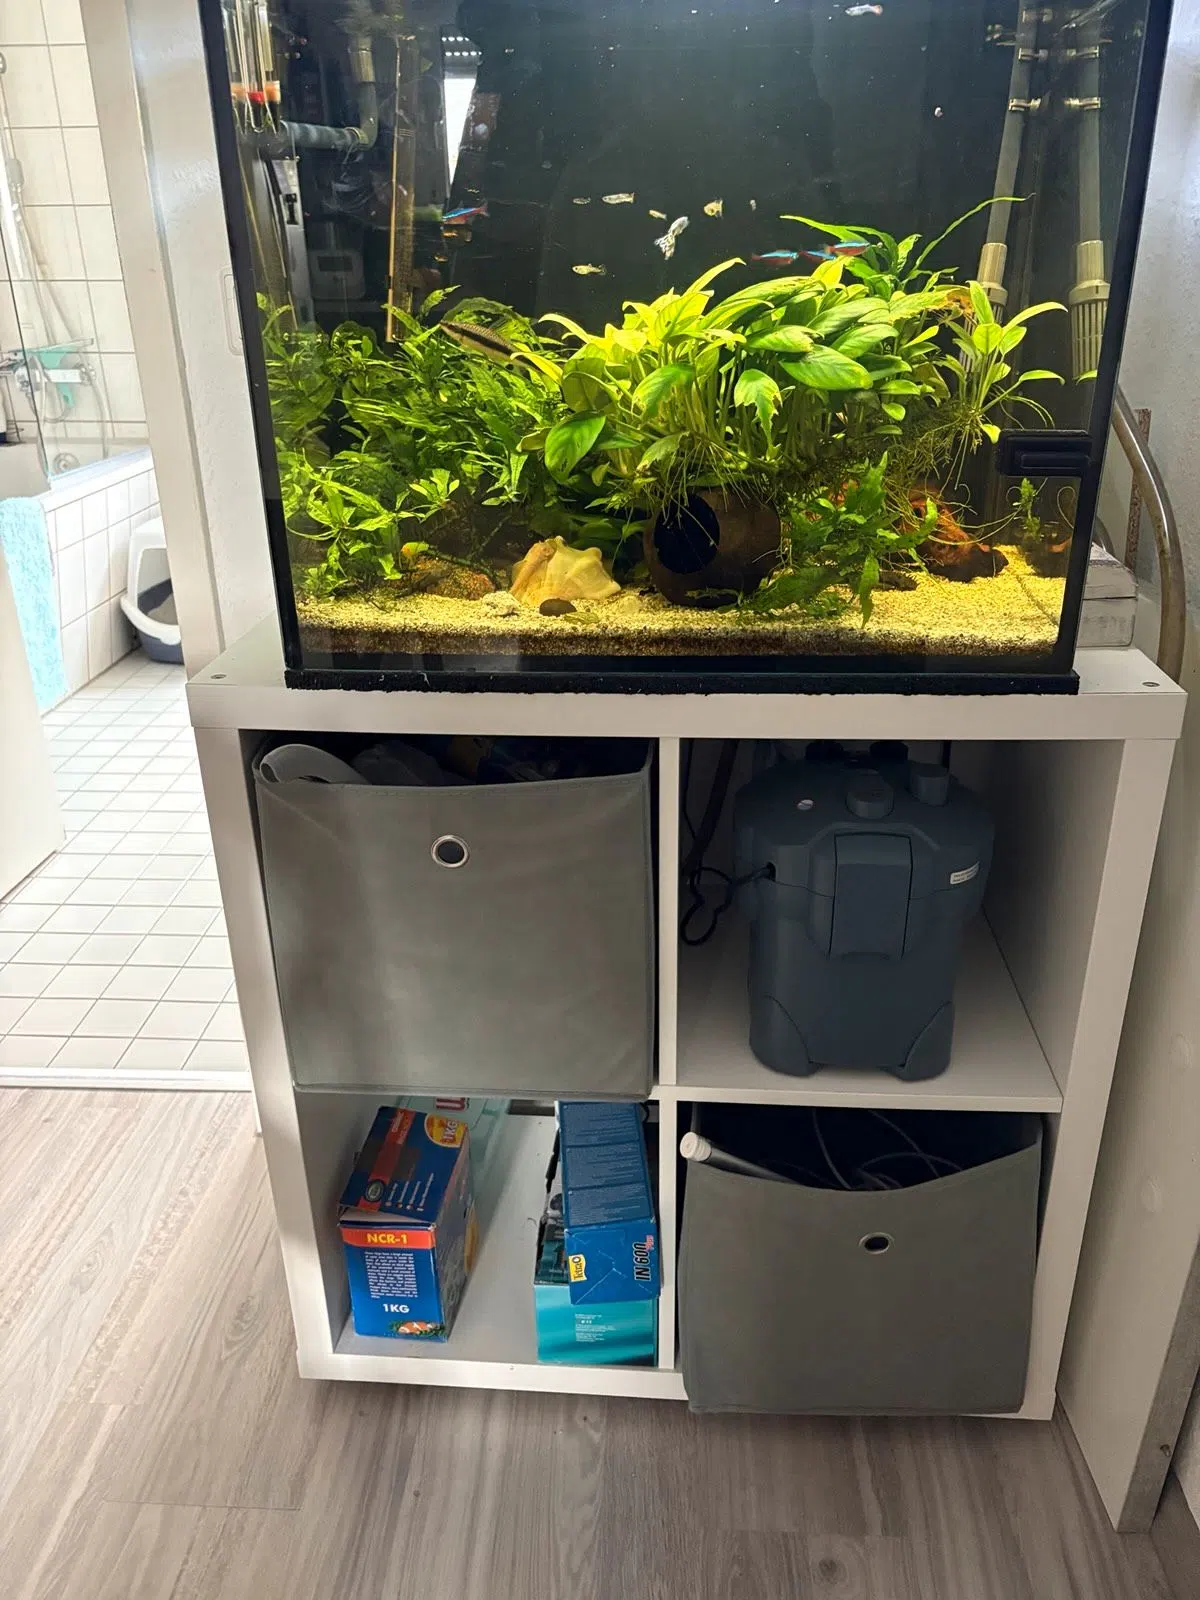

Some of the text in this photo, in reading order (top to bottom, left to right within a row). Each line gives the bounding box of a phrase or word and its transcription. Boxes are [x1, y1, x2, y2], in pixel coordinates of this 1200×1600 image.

[444, 1119, 458, 1140] 1KG
[367, 1233, 408, 1244] NCR-1
[632, 1241, 651, 1265] 600
[633, 1266, 652, 1282] IN
[382, 1303, 410, 1314] 1KG
